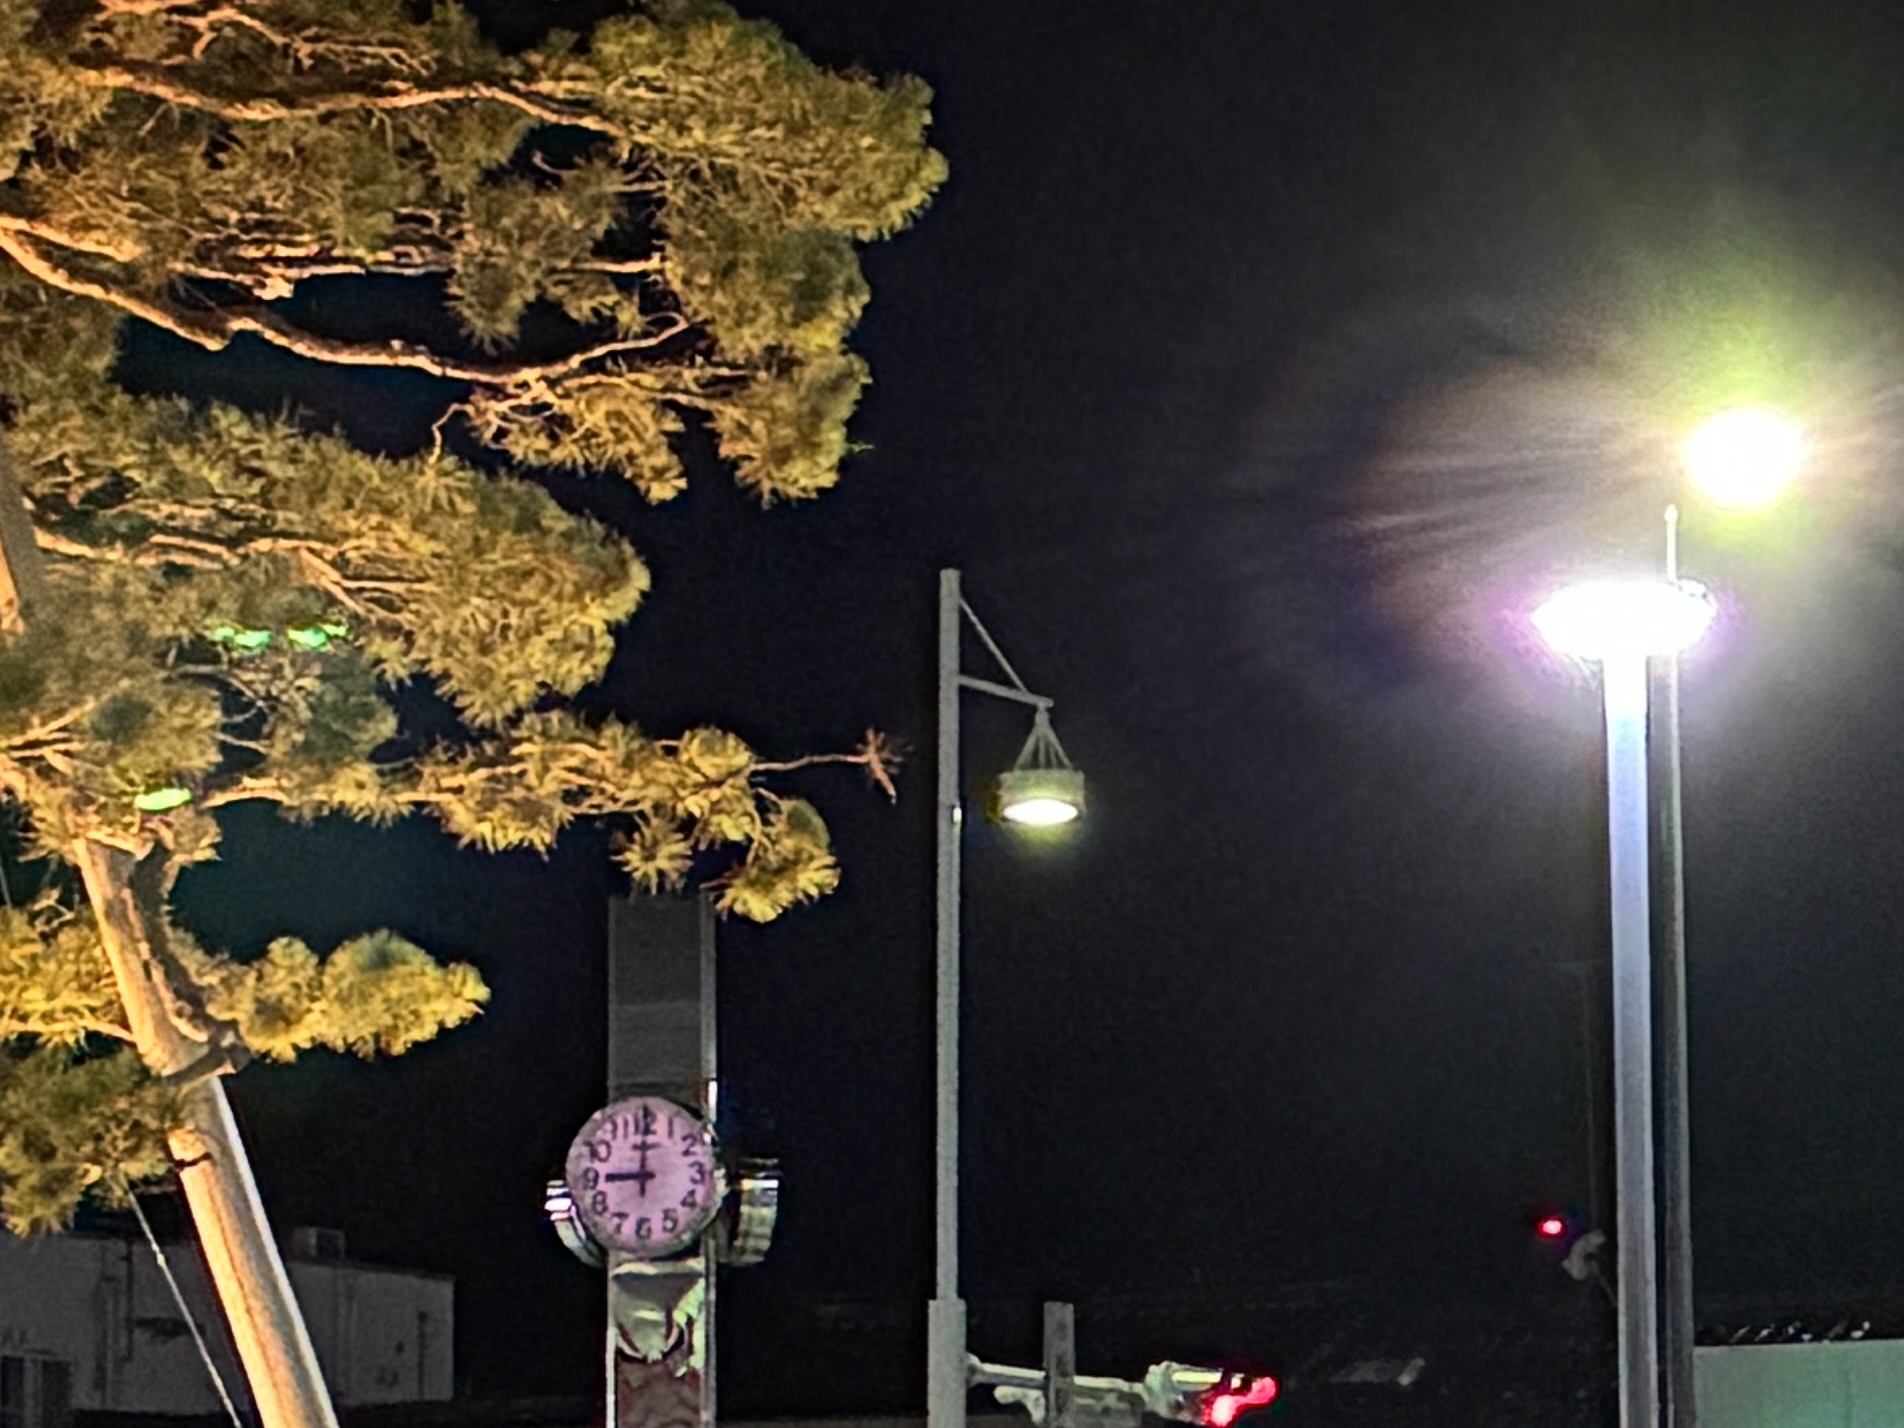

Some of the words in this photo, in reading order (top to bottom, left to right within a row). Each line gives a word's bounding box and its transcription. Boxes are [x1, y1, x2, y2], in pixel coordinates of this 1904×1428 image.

[681, 1133, 698, 1157] 2
[583, 1167, 600, 1191] 9
[688, 1160, 705, 1185] 3
[592, 1190, 608, 1215] 8
[635, 1216, 652, 1240] 6
